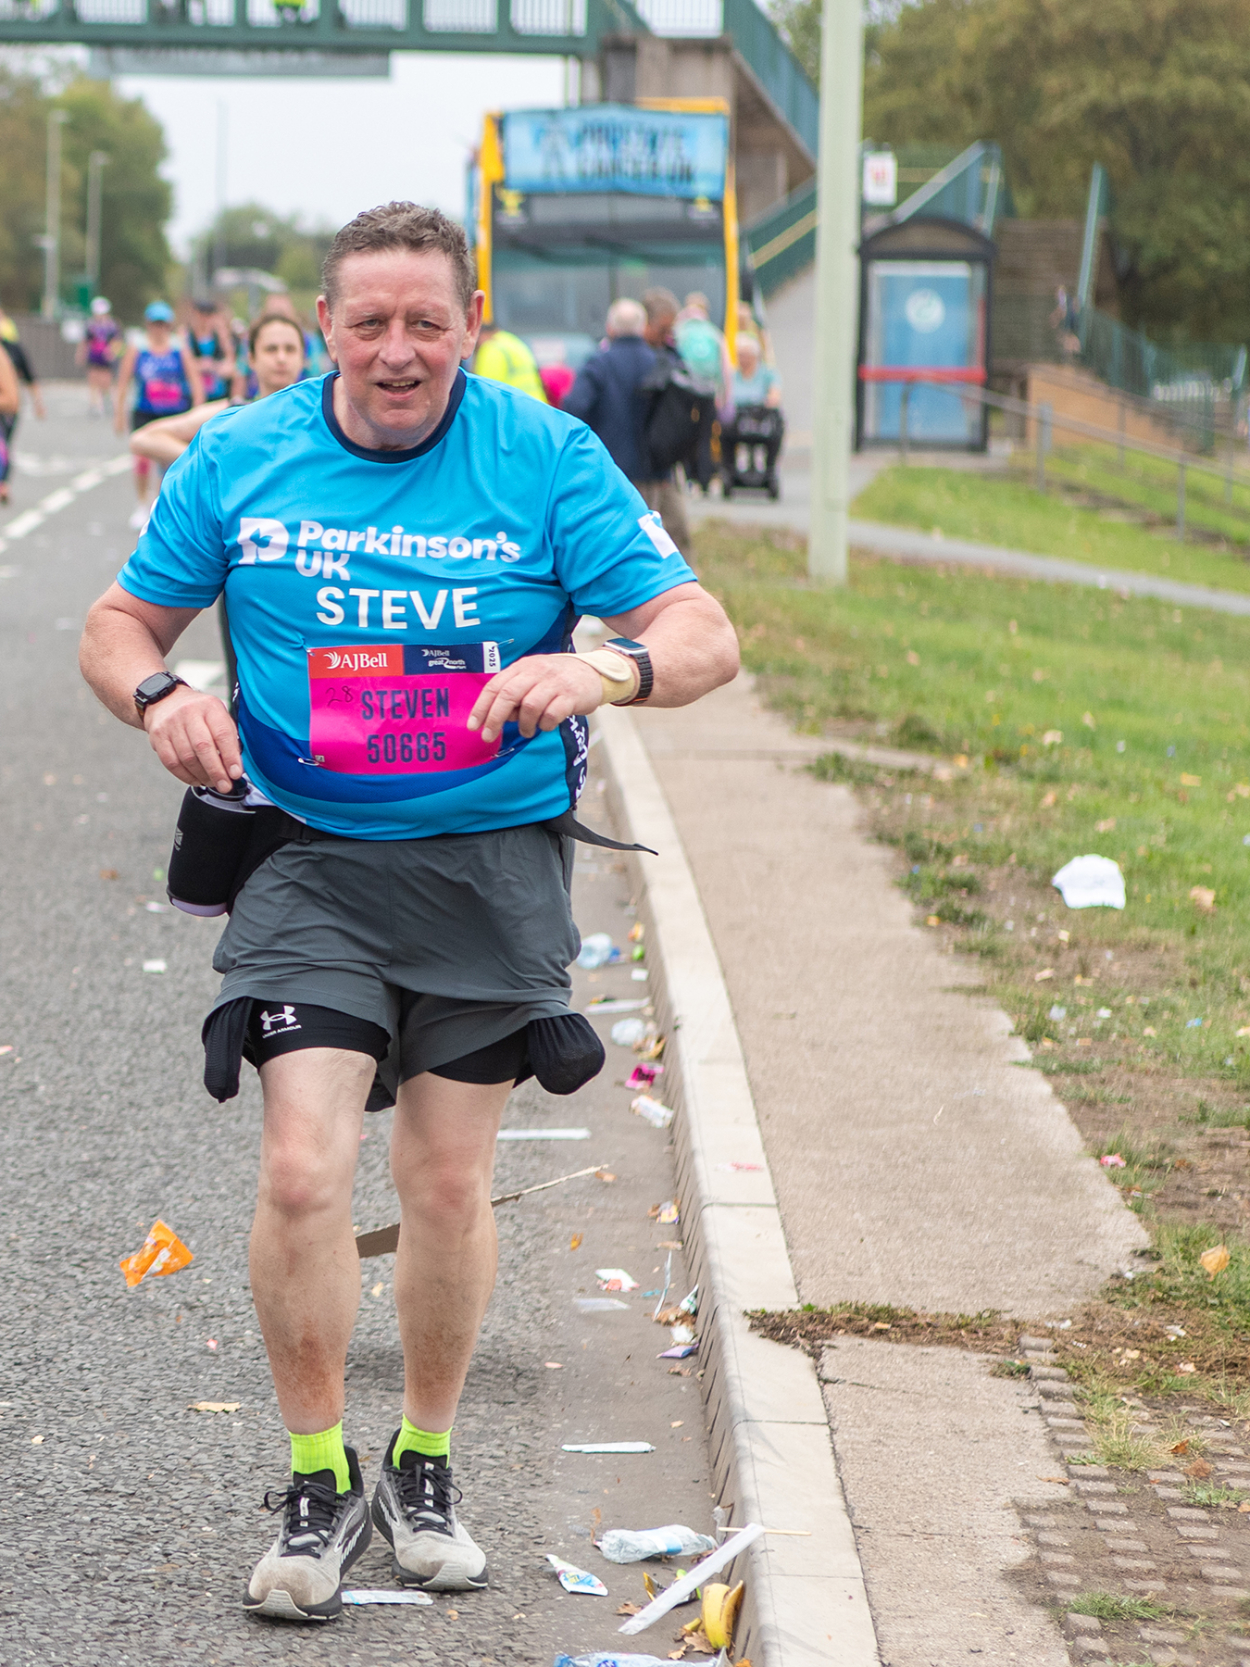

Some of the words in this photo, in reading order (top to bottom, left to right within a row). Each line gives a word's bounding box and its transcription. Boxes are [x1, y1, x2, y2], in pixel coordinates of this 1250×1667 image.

[297, 520, 521, 562] Parkinson's
[295, 549, 350, 581] UK
[316, 586, 481, 630] STEVE
[361, 688, 450, 721] STEVEN
[366, 732, 446, 764] 50665
